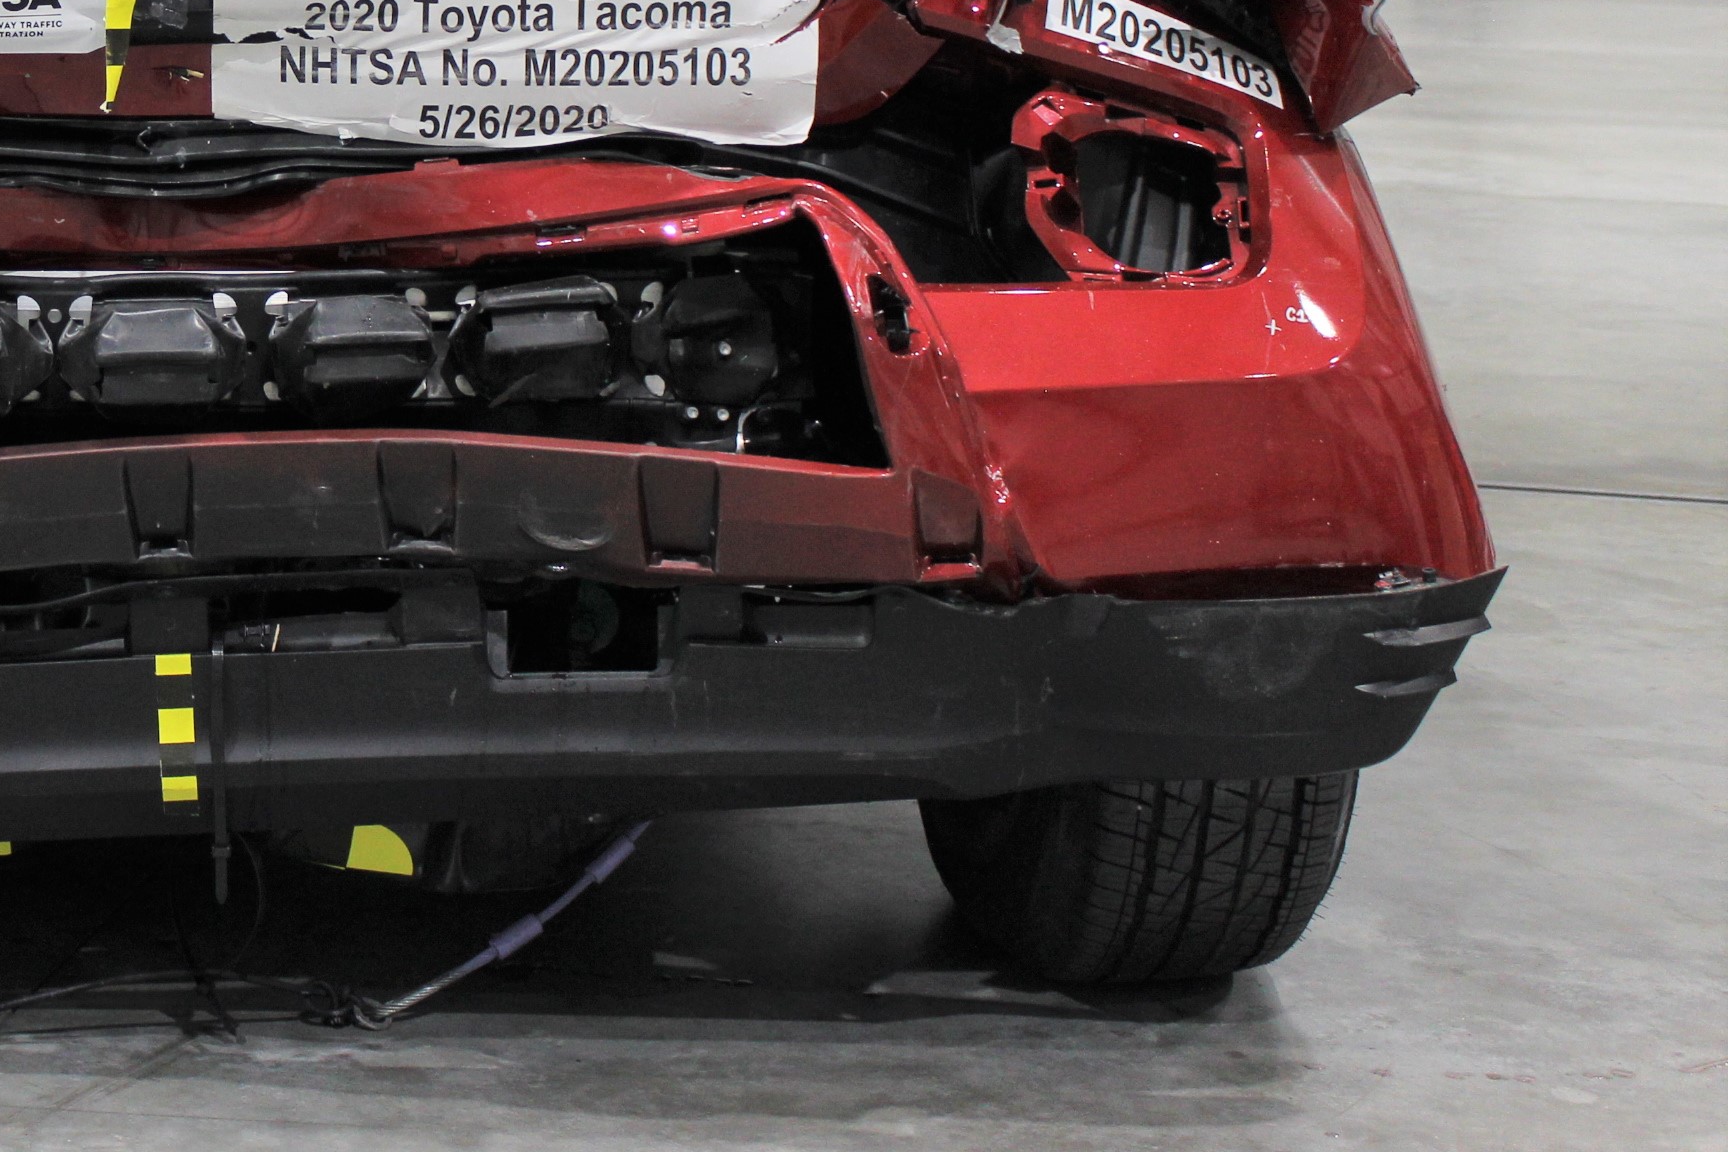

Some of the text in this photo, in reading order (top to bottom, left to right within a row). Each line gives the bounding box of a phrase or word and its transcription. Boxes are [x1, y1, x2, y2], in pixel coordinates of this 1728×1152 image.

[20, 20, 63, 28] TRAFFIC
[304, 0, 400, 32] 2020
[280, 45, 752, 87] NHTSA No. M20205103
[419, 103, 609, 140] 5/26/2020
